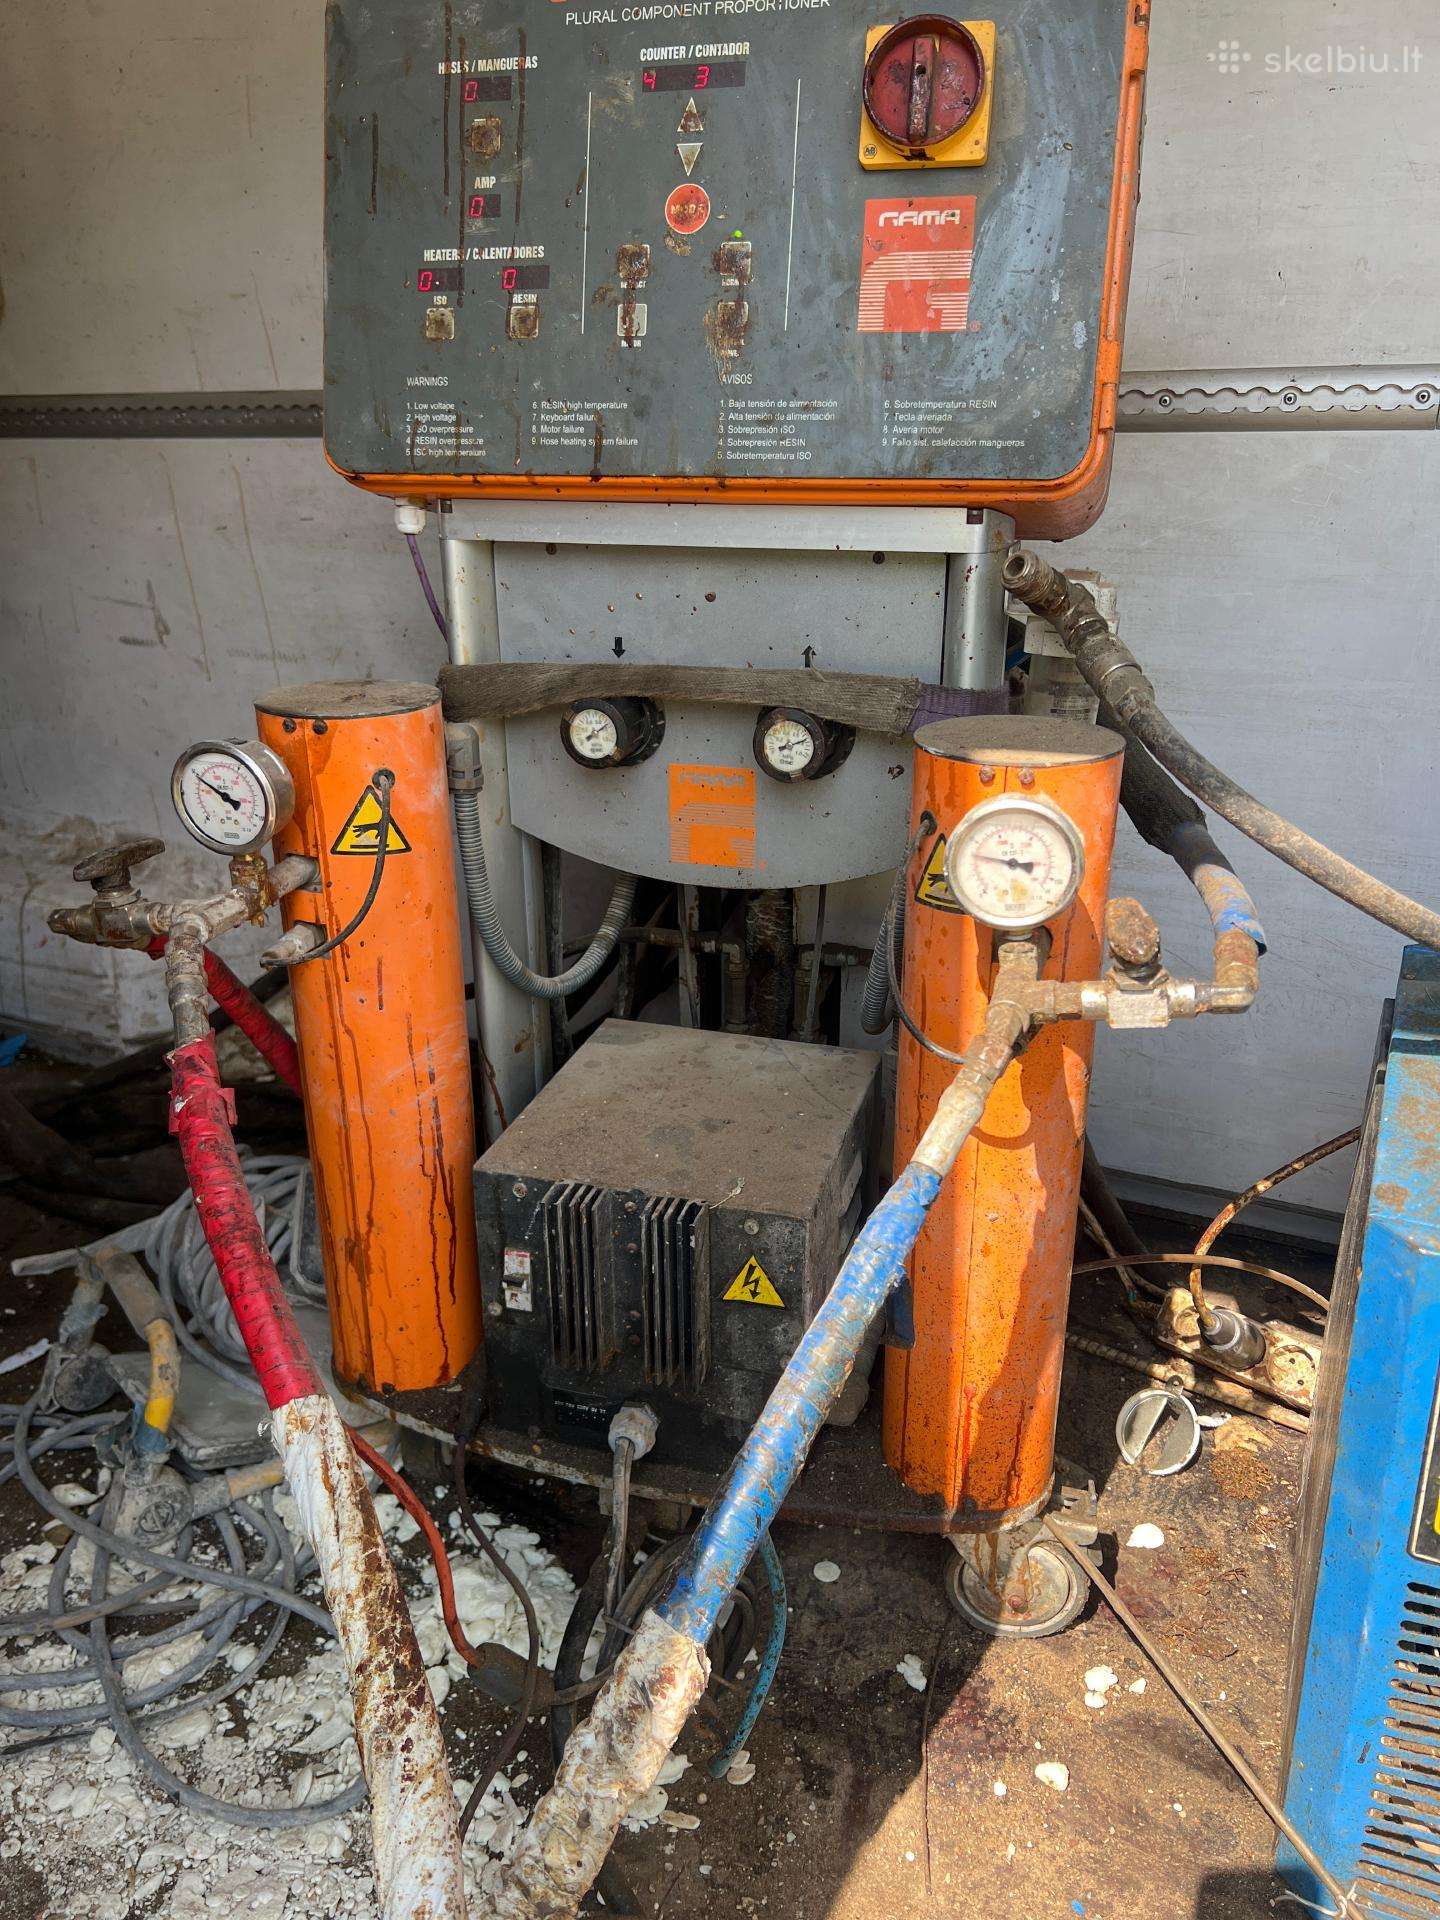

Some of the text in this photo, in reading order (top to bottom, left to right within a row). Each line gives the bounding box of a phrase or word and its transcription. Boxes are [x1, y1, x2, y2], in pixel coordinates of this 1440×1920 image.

[566, 11, 618, 26] PLURAL
[622, 2, 712, 22] COMPONENT
[640, 42, 750, 61] COUNTER / CONTADOR
[471, 60, 476, 72] /
[478, 56, 538, 72] MANGUERAS
[694, 66, 710, 90] 3
[464, 80, 478, 101] 0
[474, 176, 496, 189] AMP
[470, 197, 485, 217] 0
[878, 209, 960, 228] GAMA
[466, 248, 470, 260] /
[502, 269, 517, 289] 0
[434, 296, 448, 305] ISO
[512, 294, 537, 304] RESIN
[406, 376, 448, 386] WARNINGS
[722, 374, 752, 384] AVISOS
[414, 402, 430, 410] Low
[430, 402, 455, 411] voltage
[542, 401, 565, 410] RESIN
[566, 401, 582, 411] high
[584, 402, 628, 411] temperature
[728, 400, 746, 410] Baja
[778, 400, 787, 408] de
[894, 400, 966, 410] Sobretemperatura
[969, 400, 997, 408] RESIN
[414, 414, 430, 423] High
[432, 414, 456, 423] voltage
[540, 414, 575, 423] Keyboard
[576, 414, 597, 422] failur
[728, 412, 743, 420] Alta
[786, 412, 835, 420] alimentación
[894, 413, 916, 421] Tecla
[918, 413, 952, 421] averiada
[416, 425, 428, 433] SO
[540, 426, 561, 434] Motor
[562, 425, 584, 433] failure
[728, 425, 778, 436] Sobrepresión
[780, 426, 796, 434] ISO
[920, 426, 944, 434] motor
[540, 438, 559, 446] Hose
[560, 438, 586, 447] heating
[588, 438, 614, 447] syem
[616, 438, 638, 446] failure
[727, 438, 777, 448] Sobrepresión
[780, 438, 806, 447] RESIN
[892, 438, 912, 446] Fallo
[932, 438, 977, 446] calefacción
[979, 440, 1025, 448] mangueras
[428, 449, 444, 458] high
[726, 451, 794, 462] Sobretemperatura
[796, 451, 812, 460] ISO
